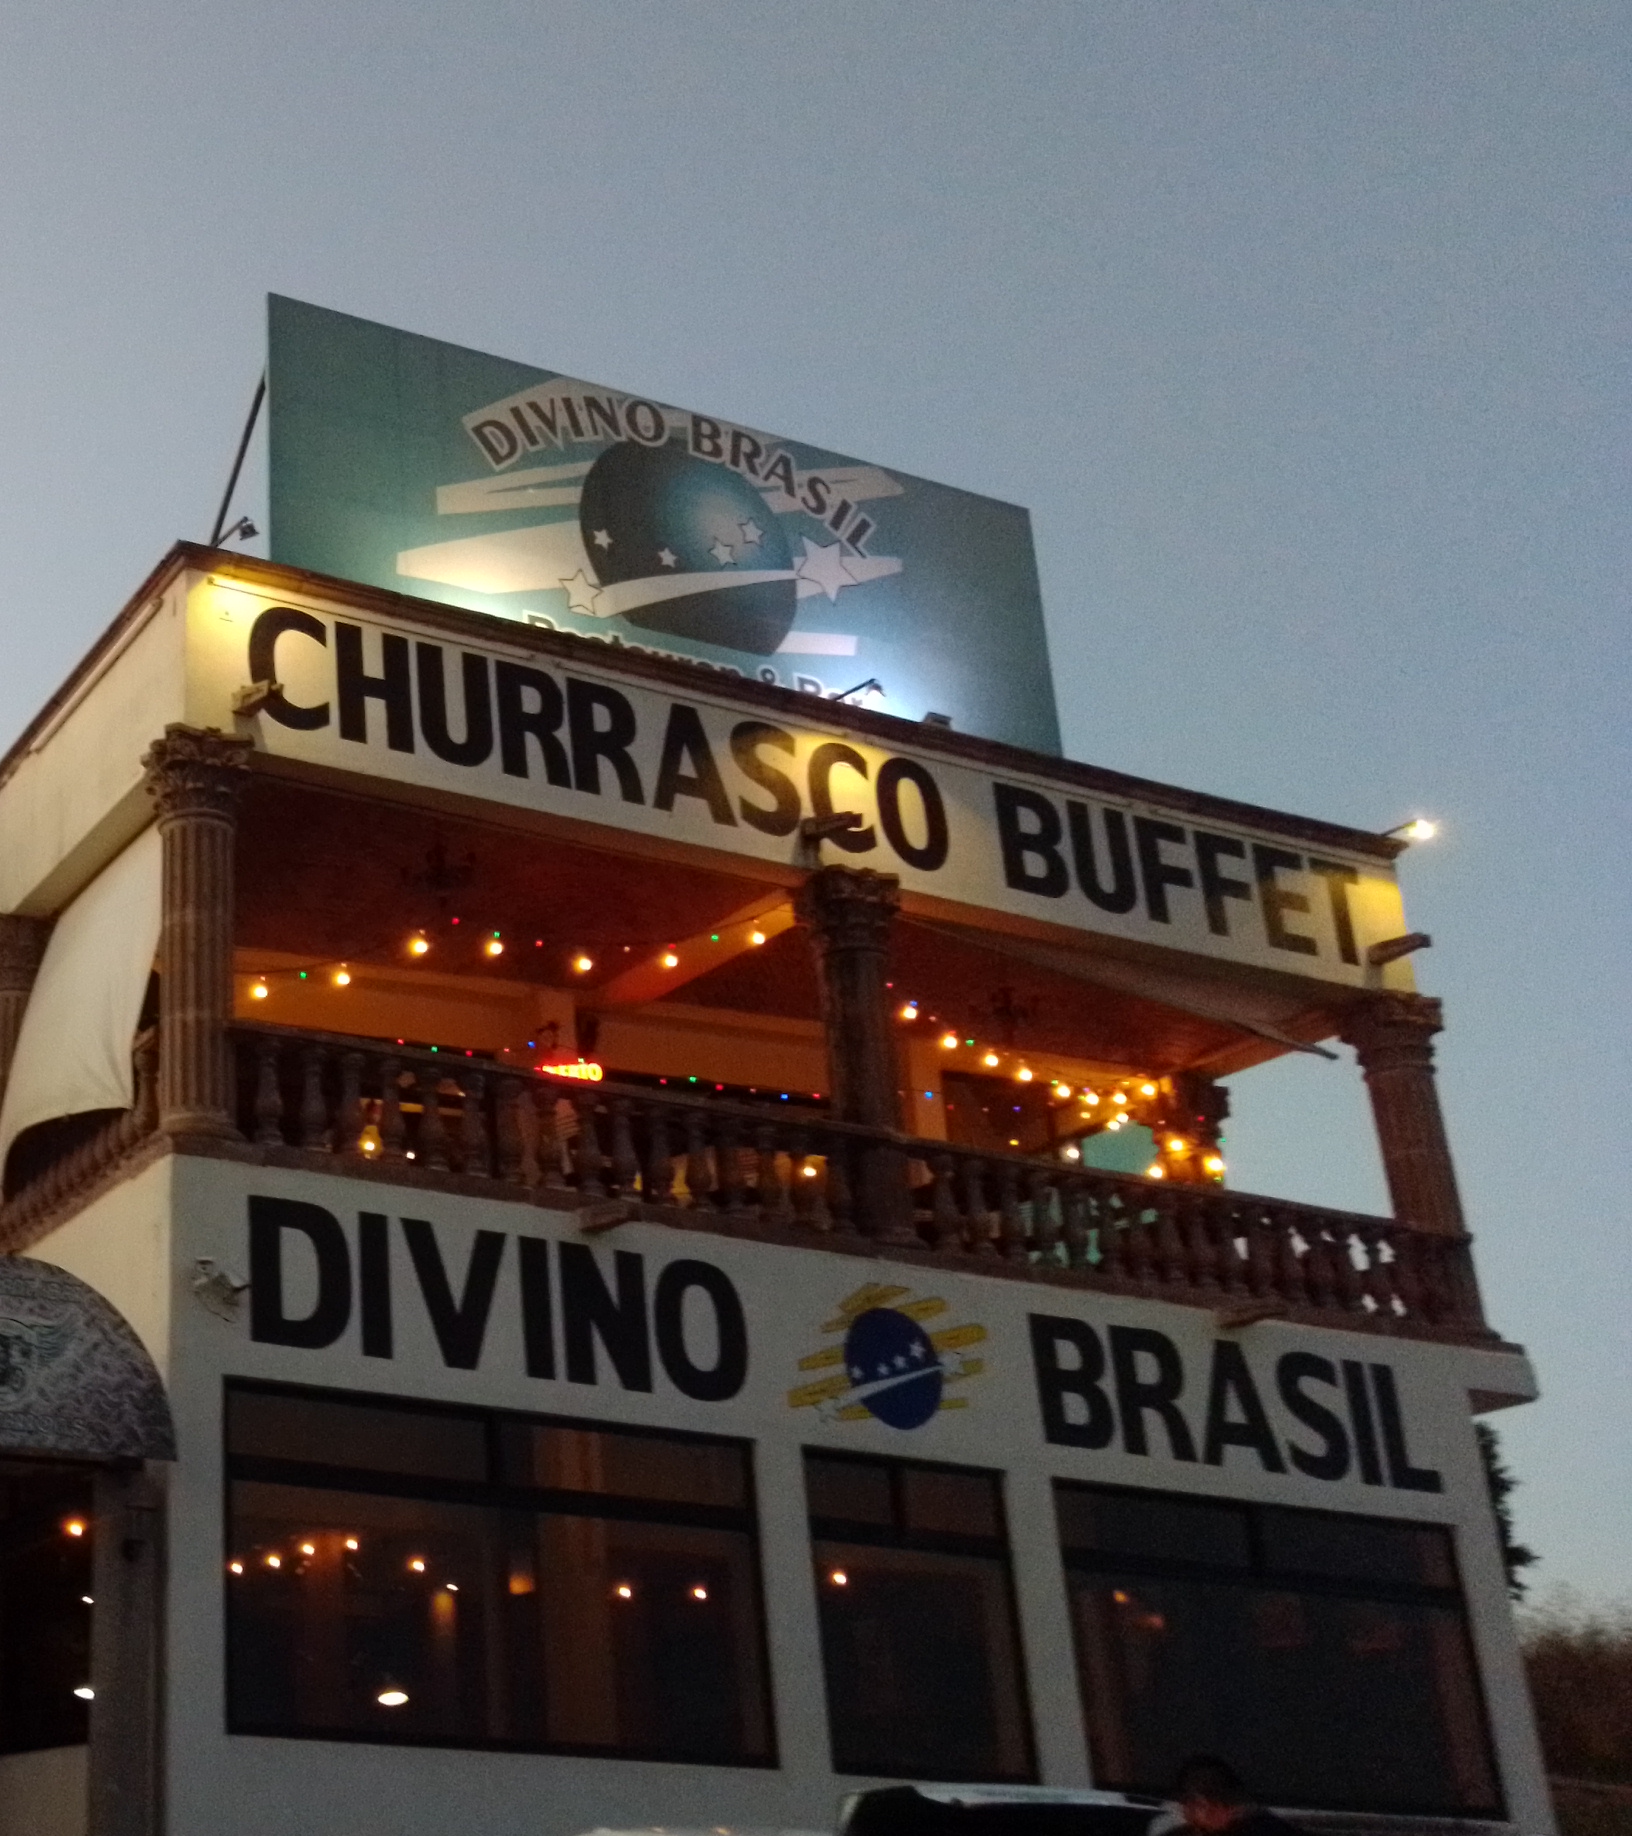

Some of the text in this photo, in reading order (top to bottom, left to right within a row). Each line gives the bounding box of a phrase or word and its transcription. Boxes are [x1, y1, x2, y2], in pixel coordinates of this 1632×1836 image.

[470, 395, 875, 556] DIVINO BRASIL
[247, 605, 1361, 967] CHURRASCO BUFFET
[247, 1194, 1444, 1494] DIVINO BRASIL
